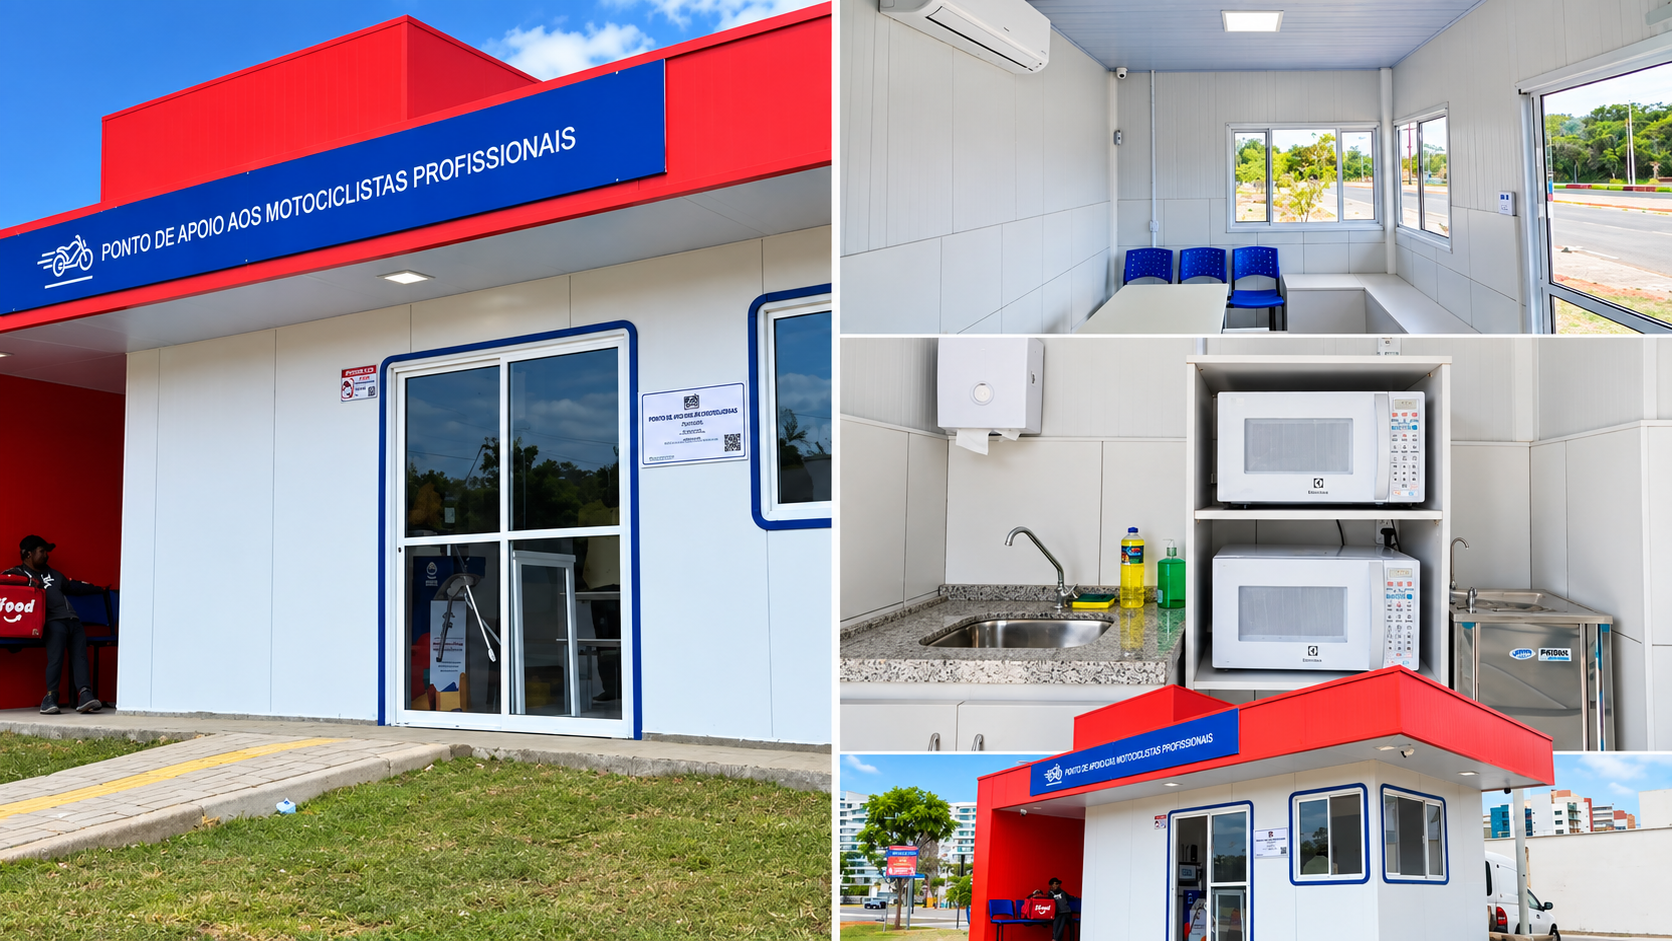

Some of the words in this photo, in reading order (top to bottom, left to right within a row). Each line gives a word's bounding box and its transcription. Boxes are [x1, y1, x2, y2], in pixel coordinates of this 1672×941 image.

[101, 233, 151, 262] PONTO
[154, 227, 175, 249] DE
[177, 215, 225, 244] APOIO
[227, 206, 262, 232] AOS
[265, 170, 408, 223] MOTOCICLISTAS
[413, 126, 577, 188] PROFISSIONAIS
[0, 597, 35, 613] food
